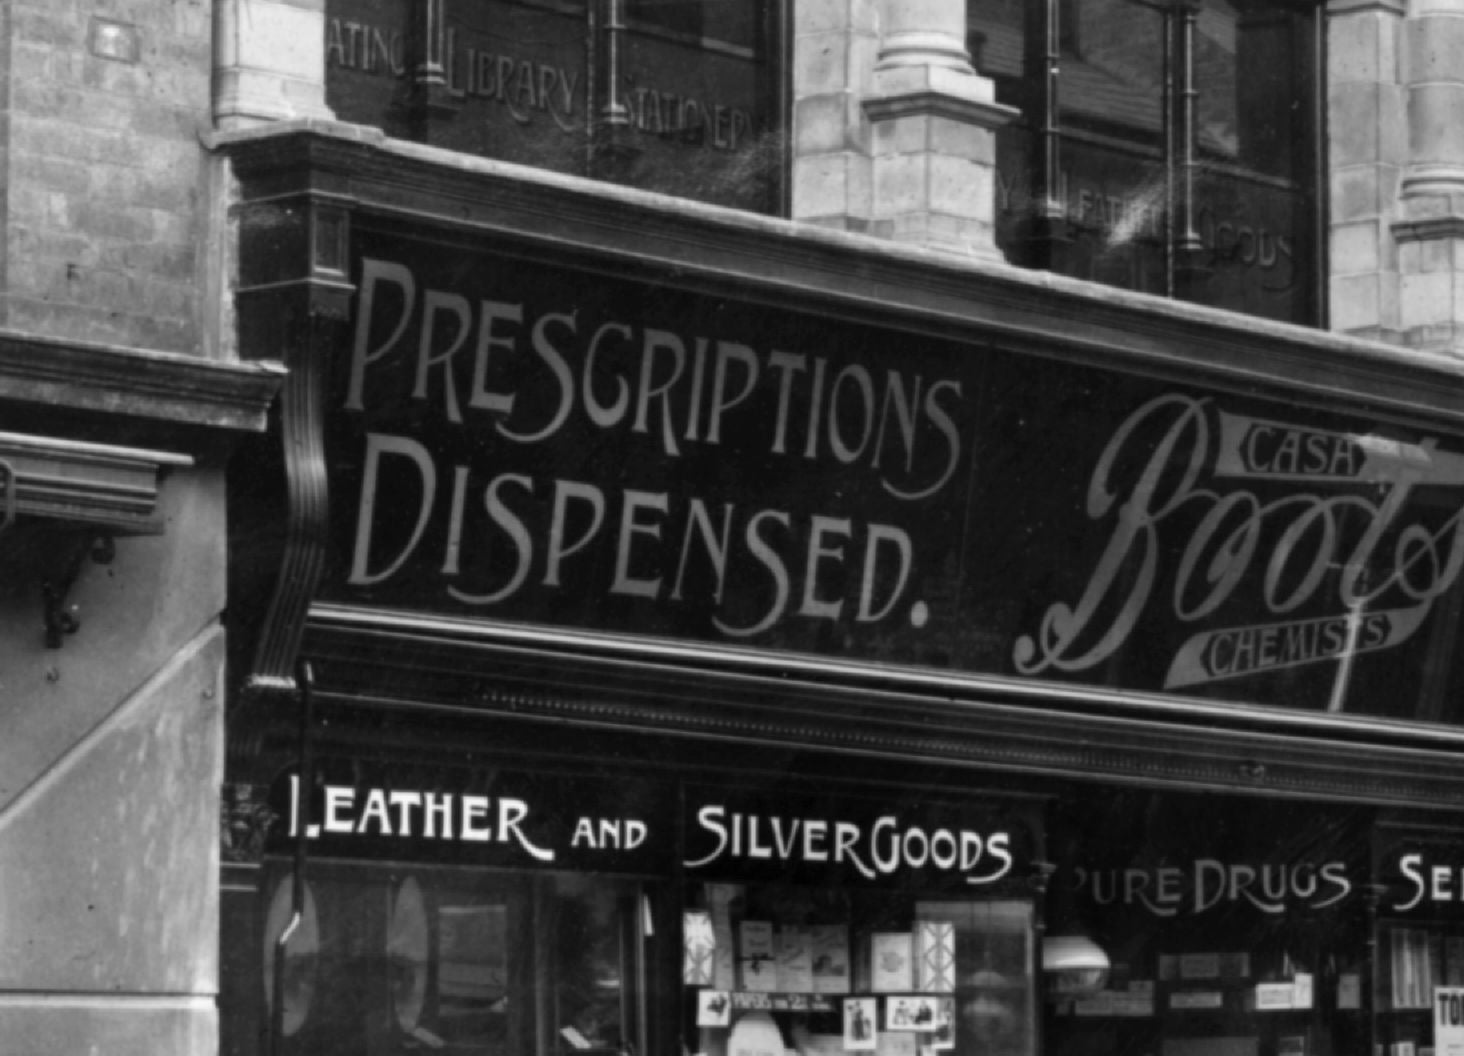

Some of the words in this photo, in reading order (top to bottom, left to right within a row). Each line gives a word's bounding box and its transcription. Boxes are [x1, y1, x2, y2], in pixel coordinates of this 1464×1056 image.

[446, 26, 583, 132] LIBRARY
[344, 256, 962, 500] PRESCRIPTIONS
[1246, 425, 1357, 475] CASH
[347, 432, 929, 638] DISPENSED.
[1208, 614, 1389, 677] CHEMISS
[289, 774, 555, 861] LEATHER
[571, 817, 648, 850] AND
[683, 805, 876, 879] SILVER
[870, 816, 1012, 884] GOODS
[1192, 857, 1352, 914] DRUGS
